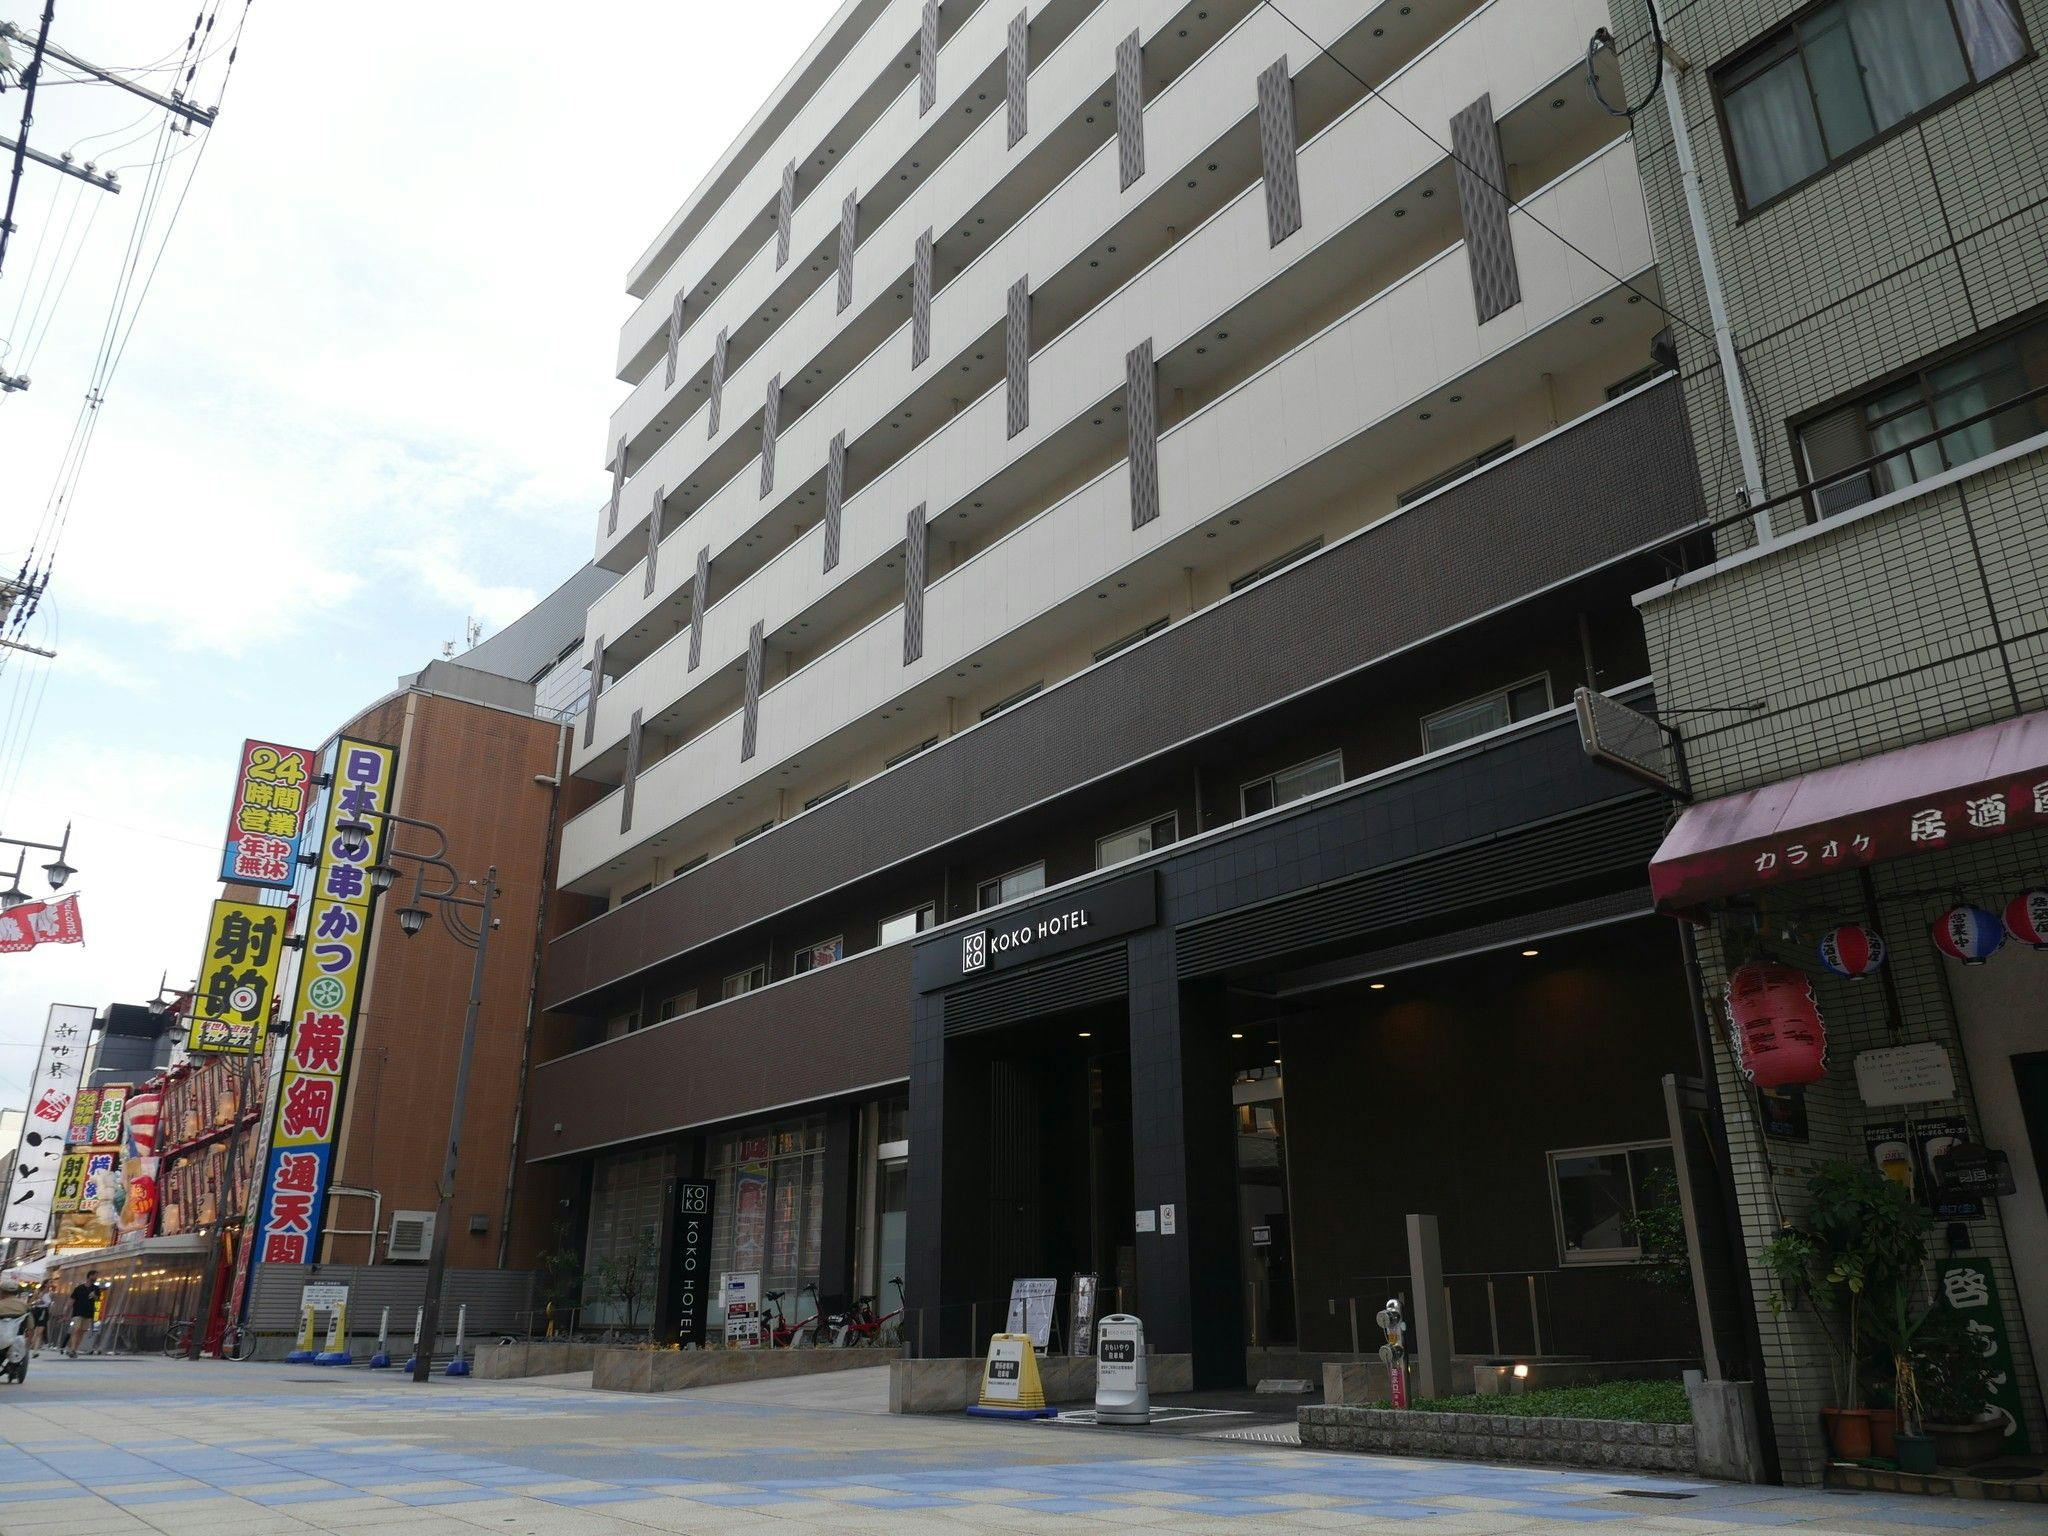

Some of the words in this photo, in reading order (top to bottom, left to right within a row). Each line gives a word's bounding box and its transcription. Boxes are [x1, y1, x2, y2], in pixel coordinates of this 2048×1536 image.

[247, 746, 306, 786] 24
[242, 780, 301, 813] 時間
[239, 806, 299, 839] 営業
[234, 854, 289, 880] 無休
[237, 834, 291, 860] 年中
[314, 749, 383, 974] 日本一の串かつ
[1755, 834, 1870, 872] カラオケ
[966, 936, 983, 953] KO
[991, 927, 1032, 954] KOKO
[1038, 909, 1088, 939] HOTEL
[1951, 913, 1969, 948] 営業中
[205, 911, 278, 1022] 射的
[966, 950, 983, 968] KO
[48, 1022, 79, 1079] 新世界
[283, 1011, 345, 1139] 横綱
[97, 1100, 112, 1142] 串かつ
[107, 1099, 125, 1142] 日本一の
[59, 1157, 84, 1198] 射的
[7, 1222, 43, 1233] 総本店
[684, 1221, 699, 1271] KOKO
[679, 1280, 695, 1338] HOTEL
